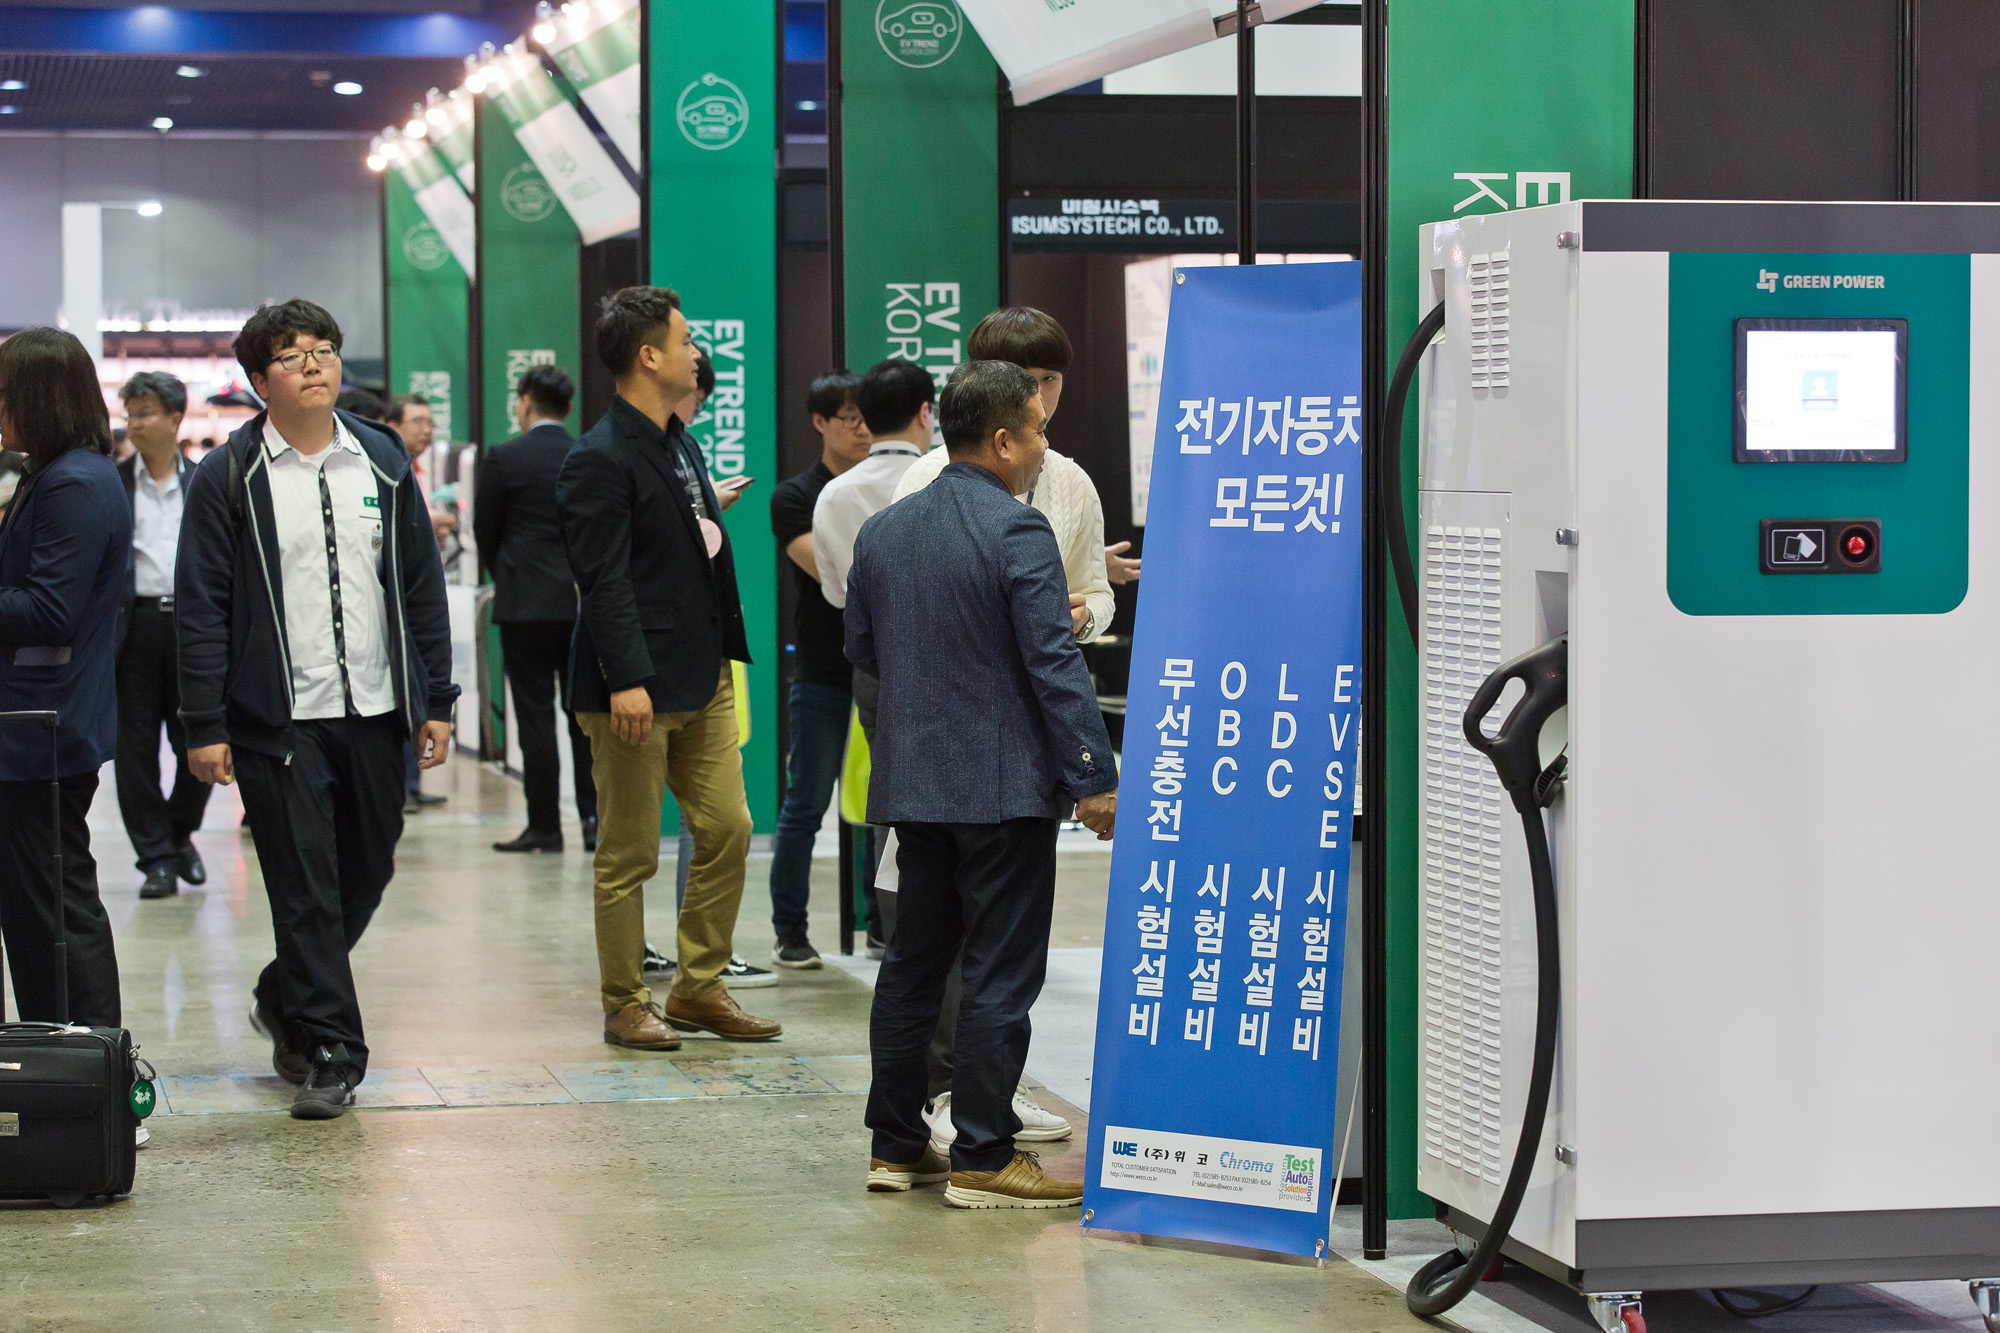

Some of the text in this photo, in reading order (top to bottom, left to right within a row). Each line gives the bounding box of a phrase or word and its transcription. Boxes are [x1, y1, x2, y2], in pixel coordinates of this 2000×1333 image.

[1516, 171, 1571, 207] E
[1144, 215, 1181, 236] CO.,
[1184, 215, 1224, 235] LTD.
[1783, 274, 1885, 289] GREEN POWER
[886, 283, 922, 361] KOR
[924, 282, 961, 333] EV
[714, 319, 745, 475] EV TREND
[1209, 473, 1344, 534] 모든것!
[1128, 658, 1196, 1046] 무선충전 시험설비
[1183, 661, 1247, 1051] OBC 시험설비
[1238, 663, 1299, 1056] LDC 시험설비
[1292, 664, 1354, 1061] EVSE 시험설비
[1111, 1162, 1125, 1170] TOTAL
[1125, 1163, 1149, 1172] CUSTOMER
[1219, 1151, 1274, 1173] Chroma
[1285, 1153, 1315, 1173] Test
[1285, 1170, 1308, 1185] Auto
[1278, 1193, 1307, 1202] provider
[1284, 1183, 1308, 1194] Solution
